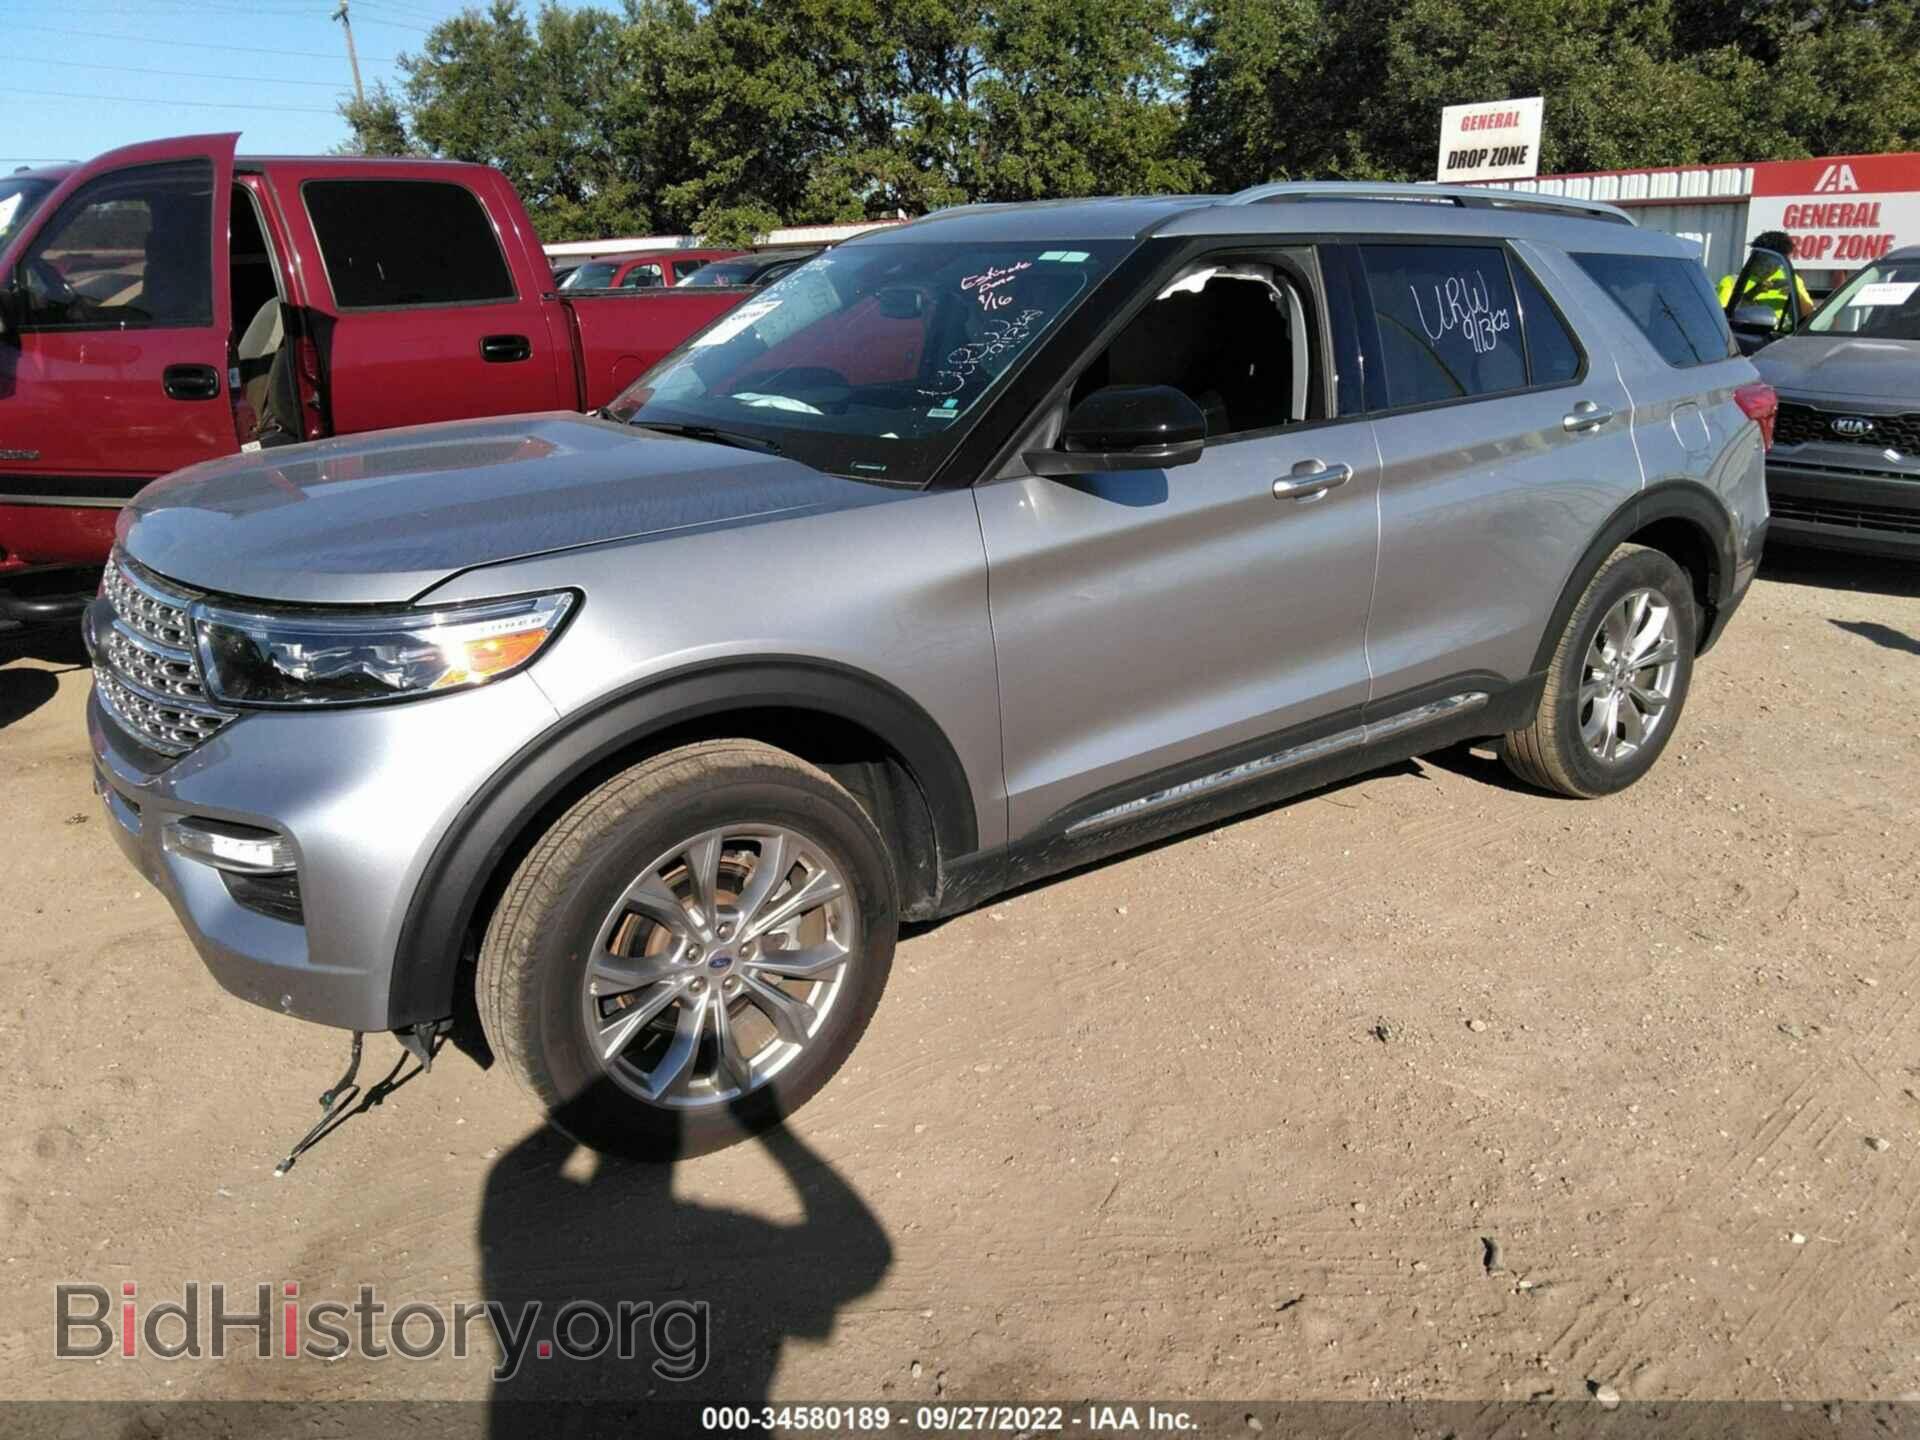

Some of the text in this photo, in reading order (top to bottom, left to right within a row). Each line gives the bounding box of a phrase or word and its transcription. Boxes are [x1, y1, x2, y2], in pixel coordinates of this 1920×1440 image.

[1460, 111, 1520, 132] GENERAL
[1446, 145, 1529, 170] DROP ZONE
[1782, 202, 1881, 229] GENERAL
[1789, 235, 1833, 261] ROP
[1837, 420, 1865, 433] KIA
